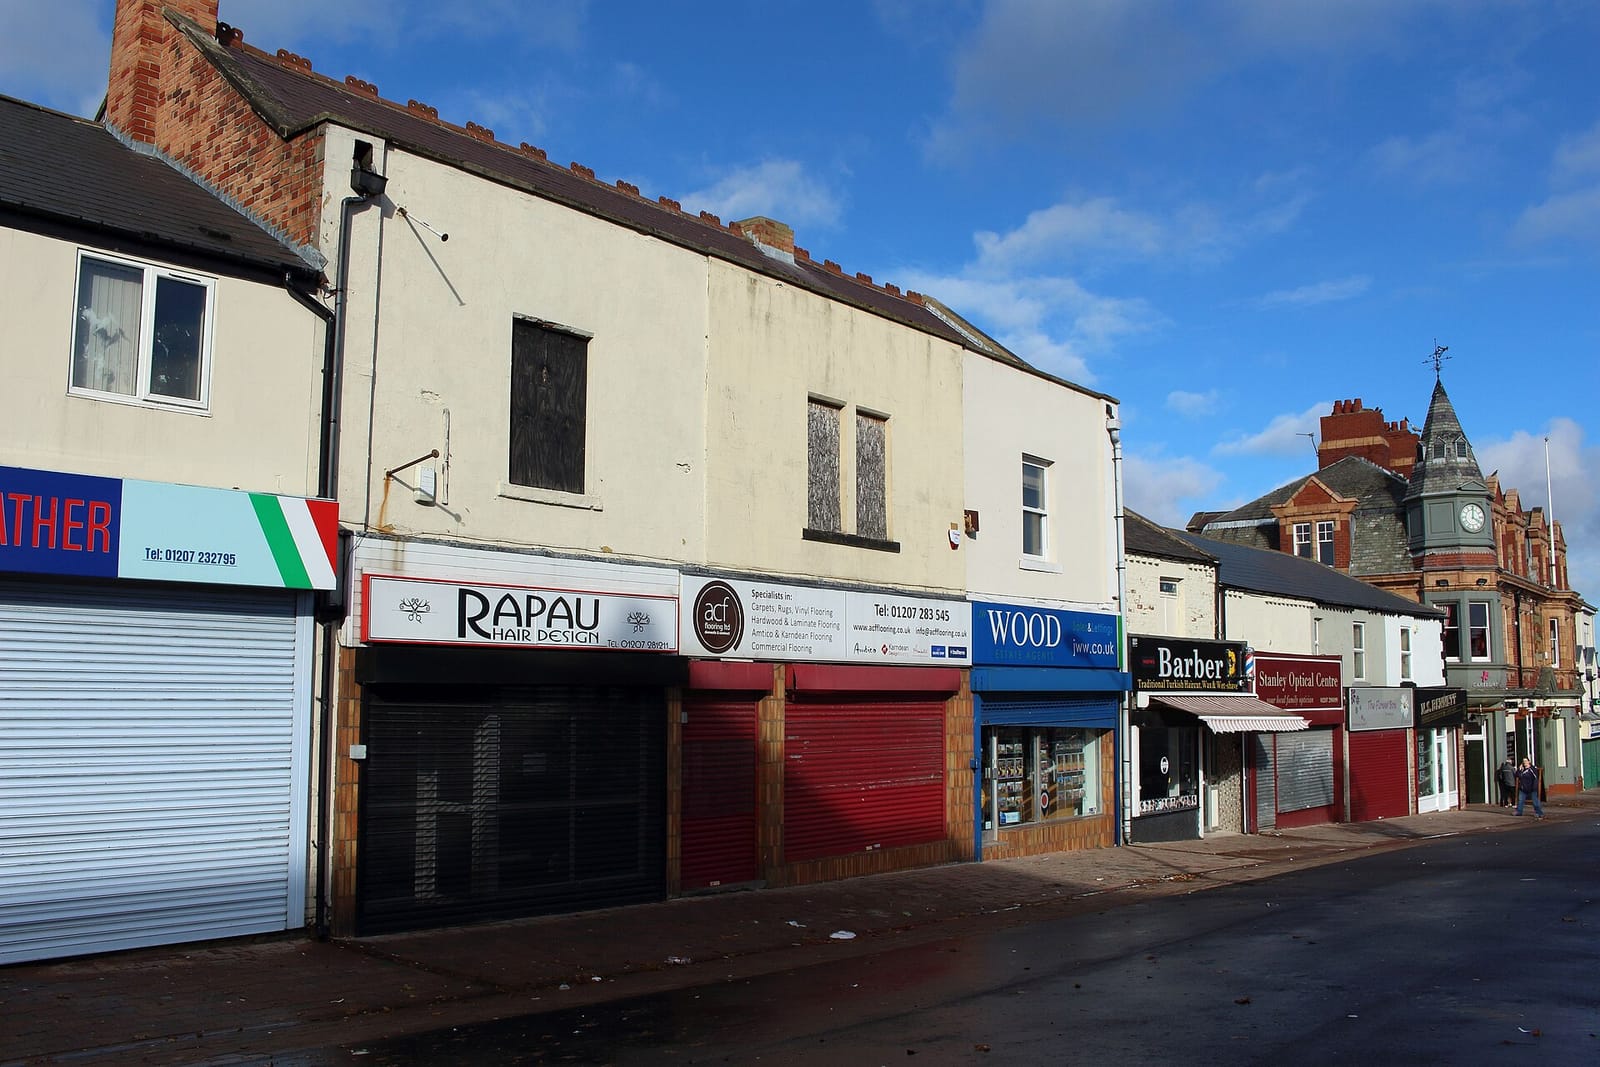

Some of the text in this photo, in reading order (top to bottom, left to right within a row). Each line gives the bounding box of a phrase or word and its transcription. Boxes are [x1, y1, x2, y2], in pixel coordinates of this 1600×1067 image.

[0, 491, 112, 554] THER
[145, 547, 237, 565] Tel: 01207 232795
[751, 589, 793, 601] Specialists in:
[457, 588, 600, 641] RAPAU
[704, 596, 730, 622] acf
[751, 602, 834, 619] Carpets, Rugs, Vinyl Flooring
[874, 604, 950, 622] Tel: 01207 283 545
[751, 616, 841, 631] Hardwood & Laminate Flooring
[986, 609, 1062, 647] WOOD
[1087, 622, 1092, 632] &
[492, 627, 600, 645] HAIR DESIGN
[620, 639, 646, 649] 01207
[751, 628, 833, 643] Amtico & Karndean Flooring
[751, 642, 813, 654] Commercial Flooring
[1072, 638, 1115, 657] jww.co.uk
[1157, 646, 1224, 679] Barber
[1137, 679, 1165, 689] Traditional
[1165, 679, 1184, 689] Turkish
[1259, 670, 1338, 692] Stanley Optical Centre
